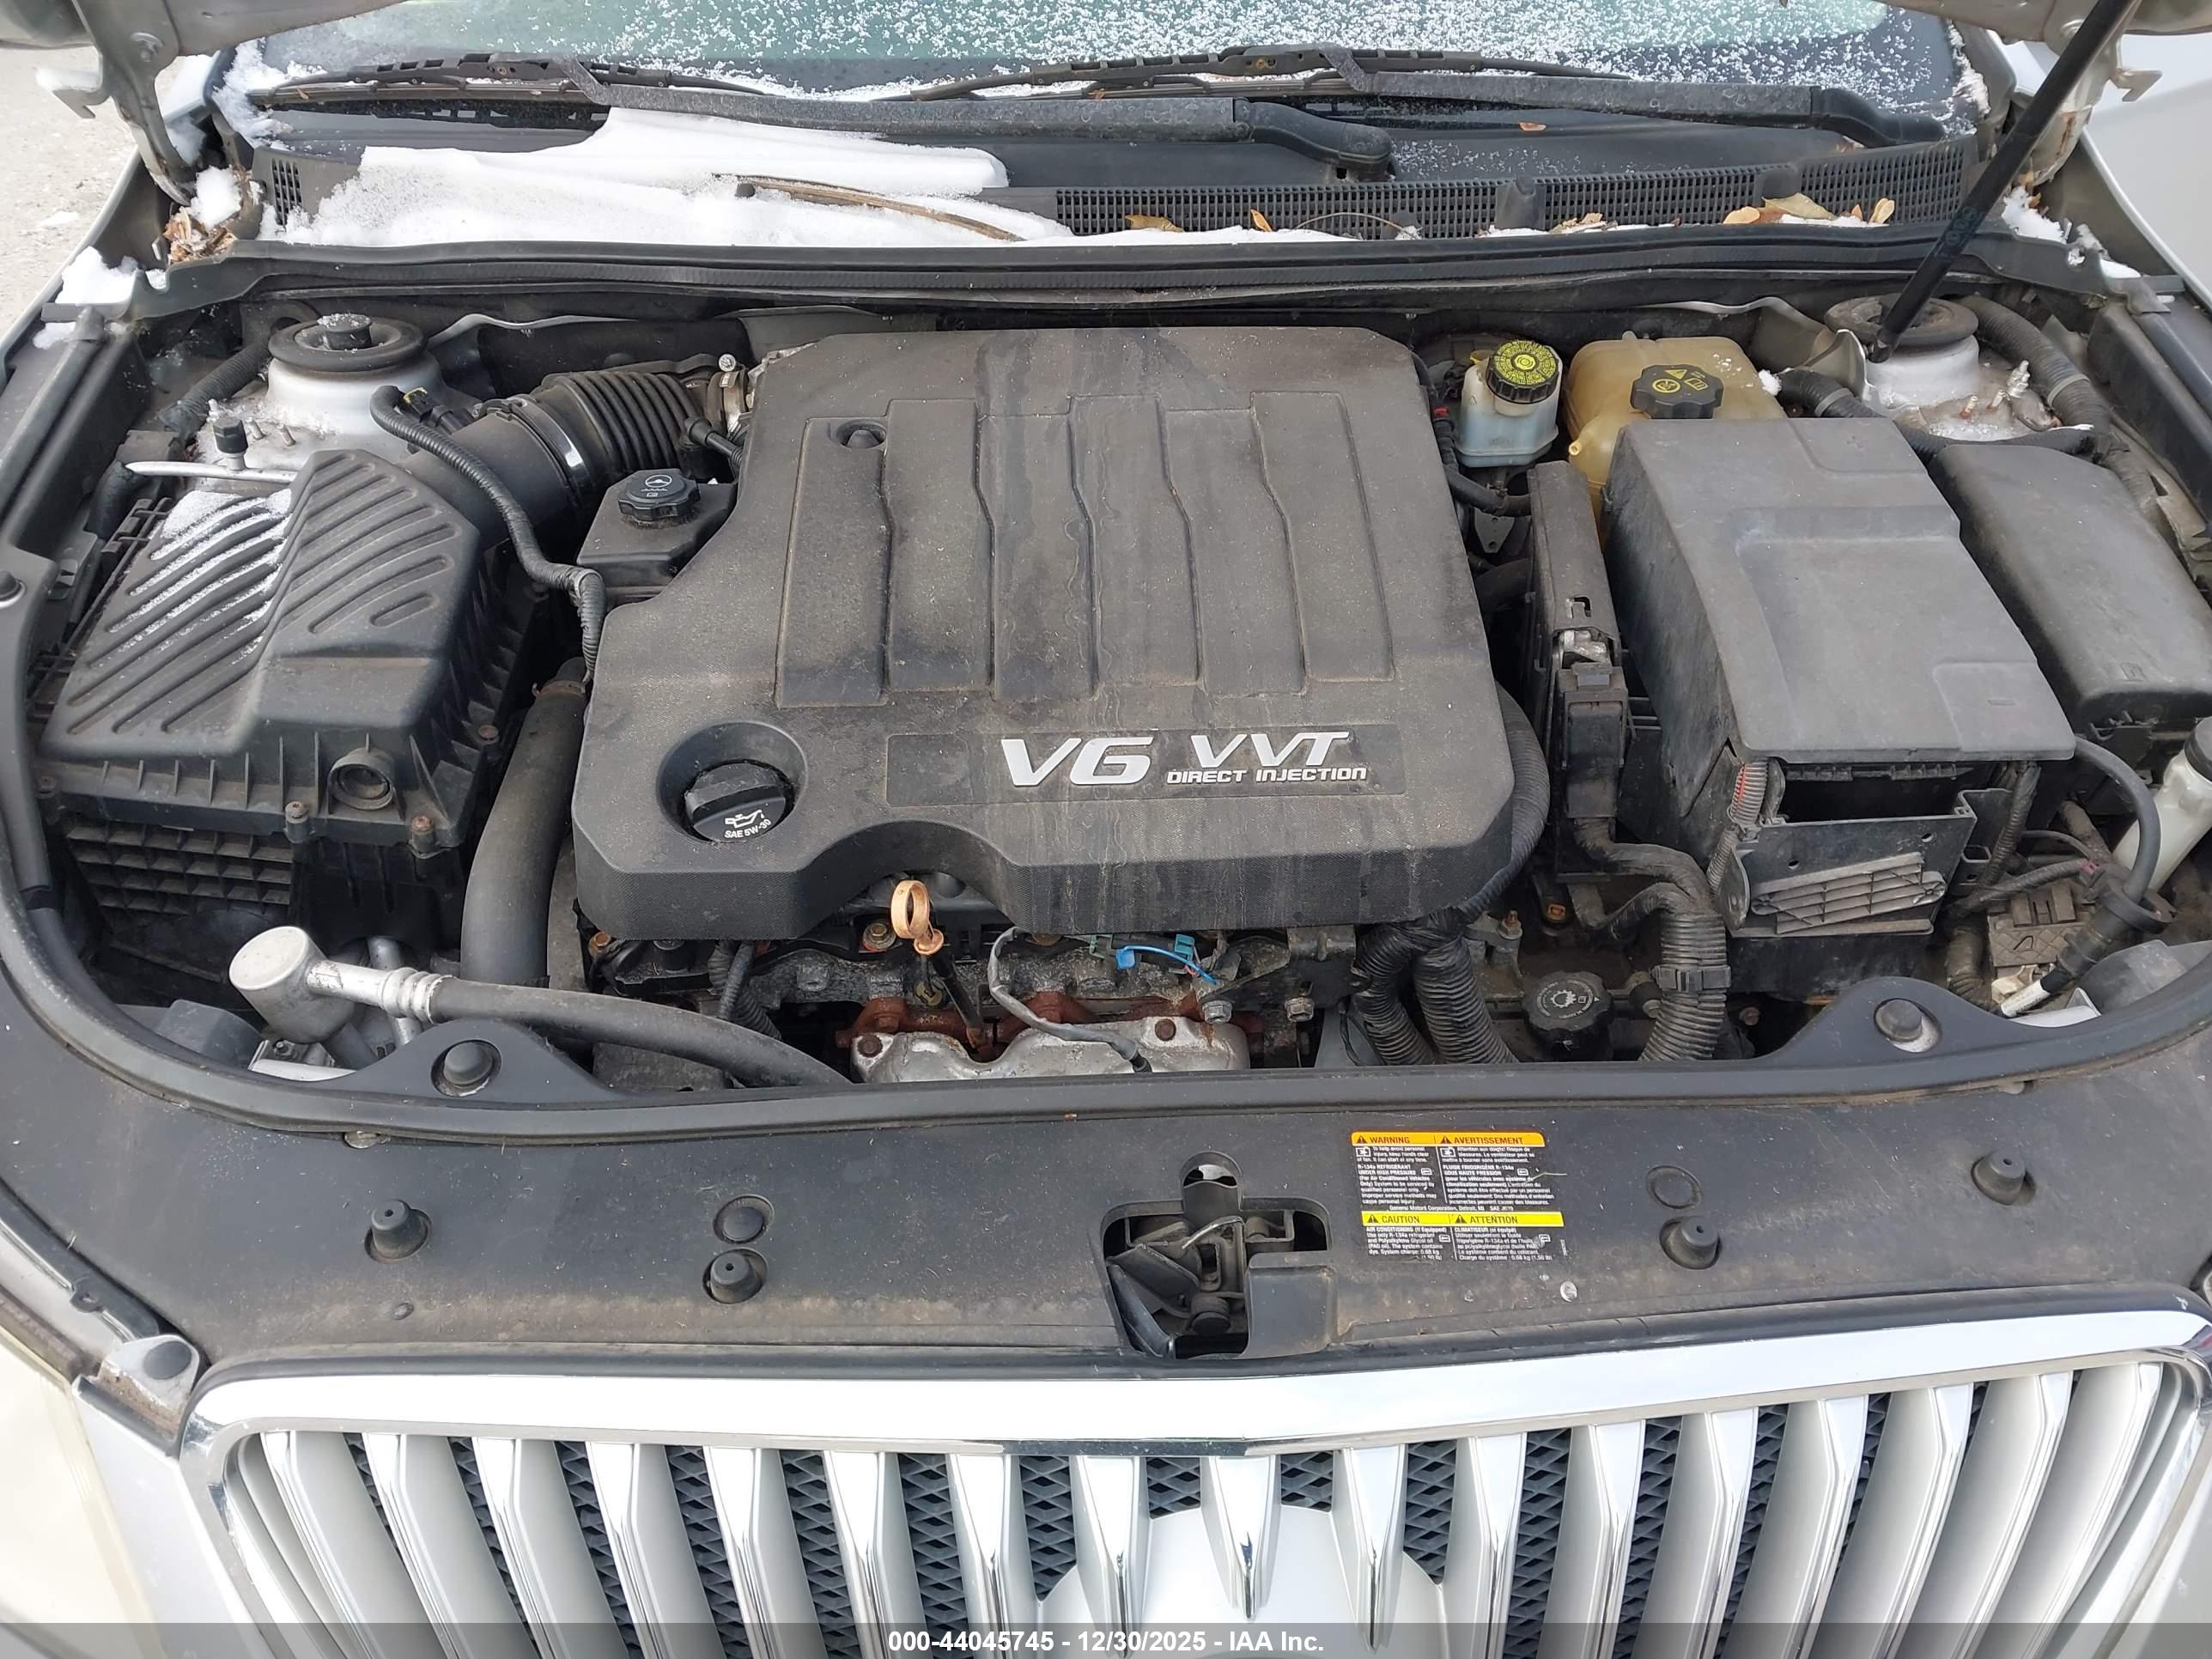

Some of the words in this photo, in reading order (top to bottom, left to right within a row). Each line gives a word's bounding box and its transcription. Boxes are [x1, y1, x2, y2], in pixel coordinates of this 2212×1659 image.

[1000, 736, 1154, 787] V6
[1191, 732, 1350, 768] VVT
[1167, 769, 1247, 784] DIRECT
[1256, 769, 1367, 784] INJECTION
[744, 819, 771, 836] 5W-30
